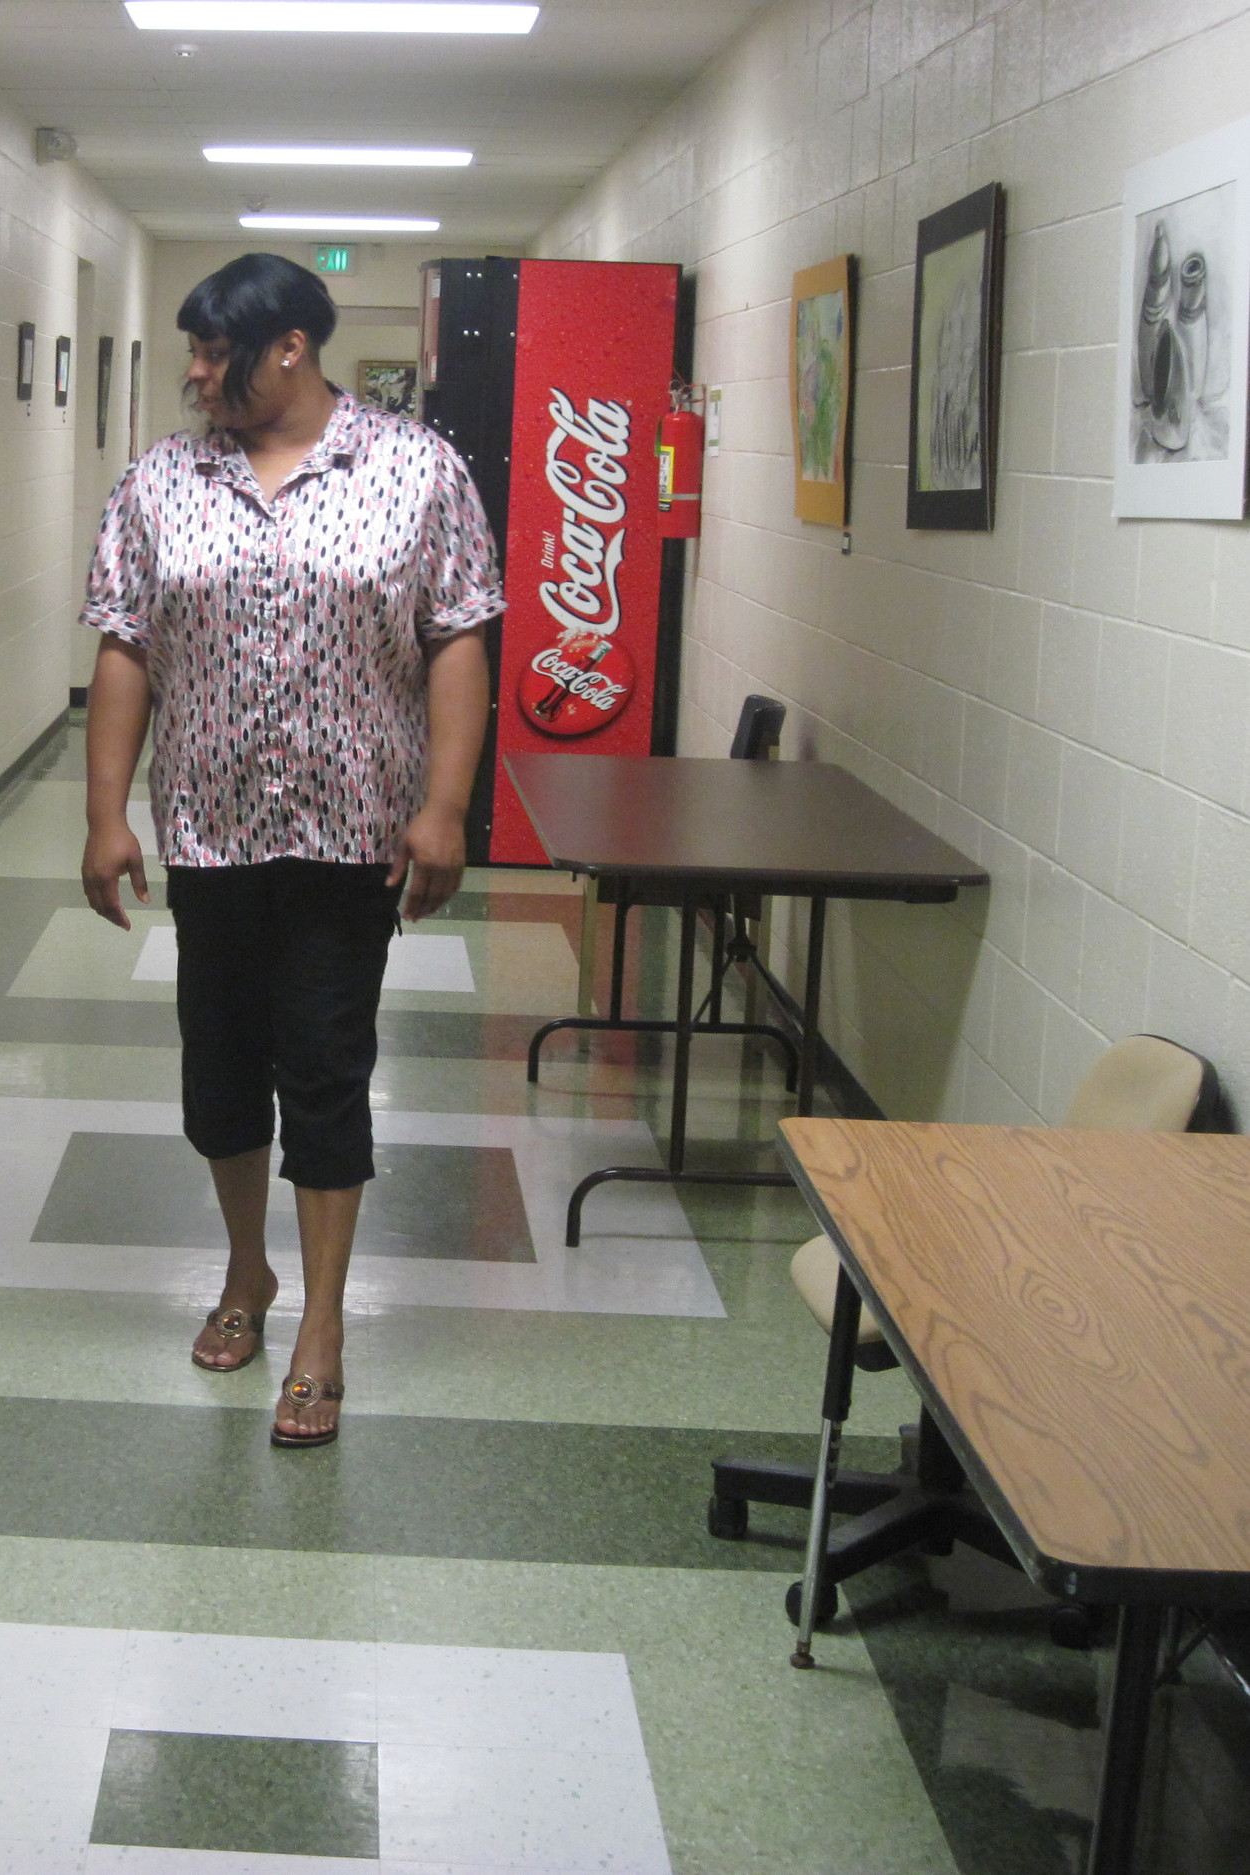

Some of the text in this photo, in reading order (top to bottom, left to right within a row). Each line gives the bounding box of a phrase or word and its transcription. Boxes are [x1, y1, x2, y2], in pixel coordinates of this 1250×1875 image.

[540, 387, 630, 637] Coca-Cola
[541, 530, 556, 570] Drink!
[532, 648, 627, 711] Coca-Cola
